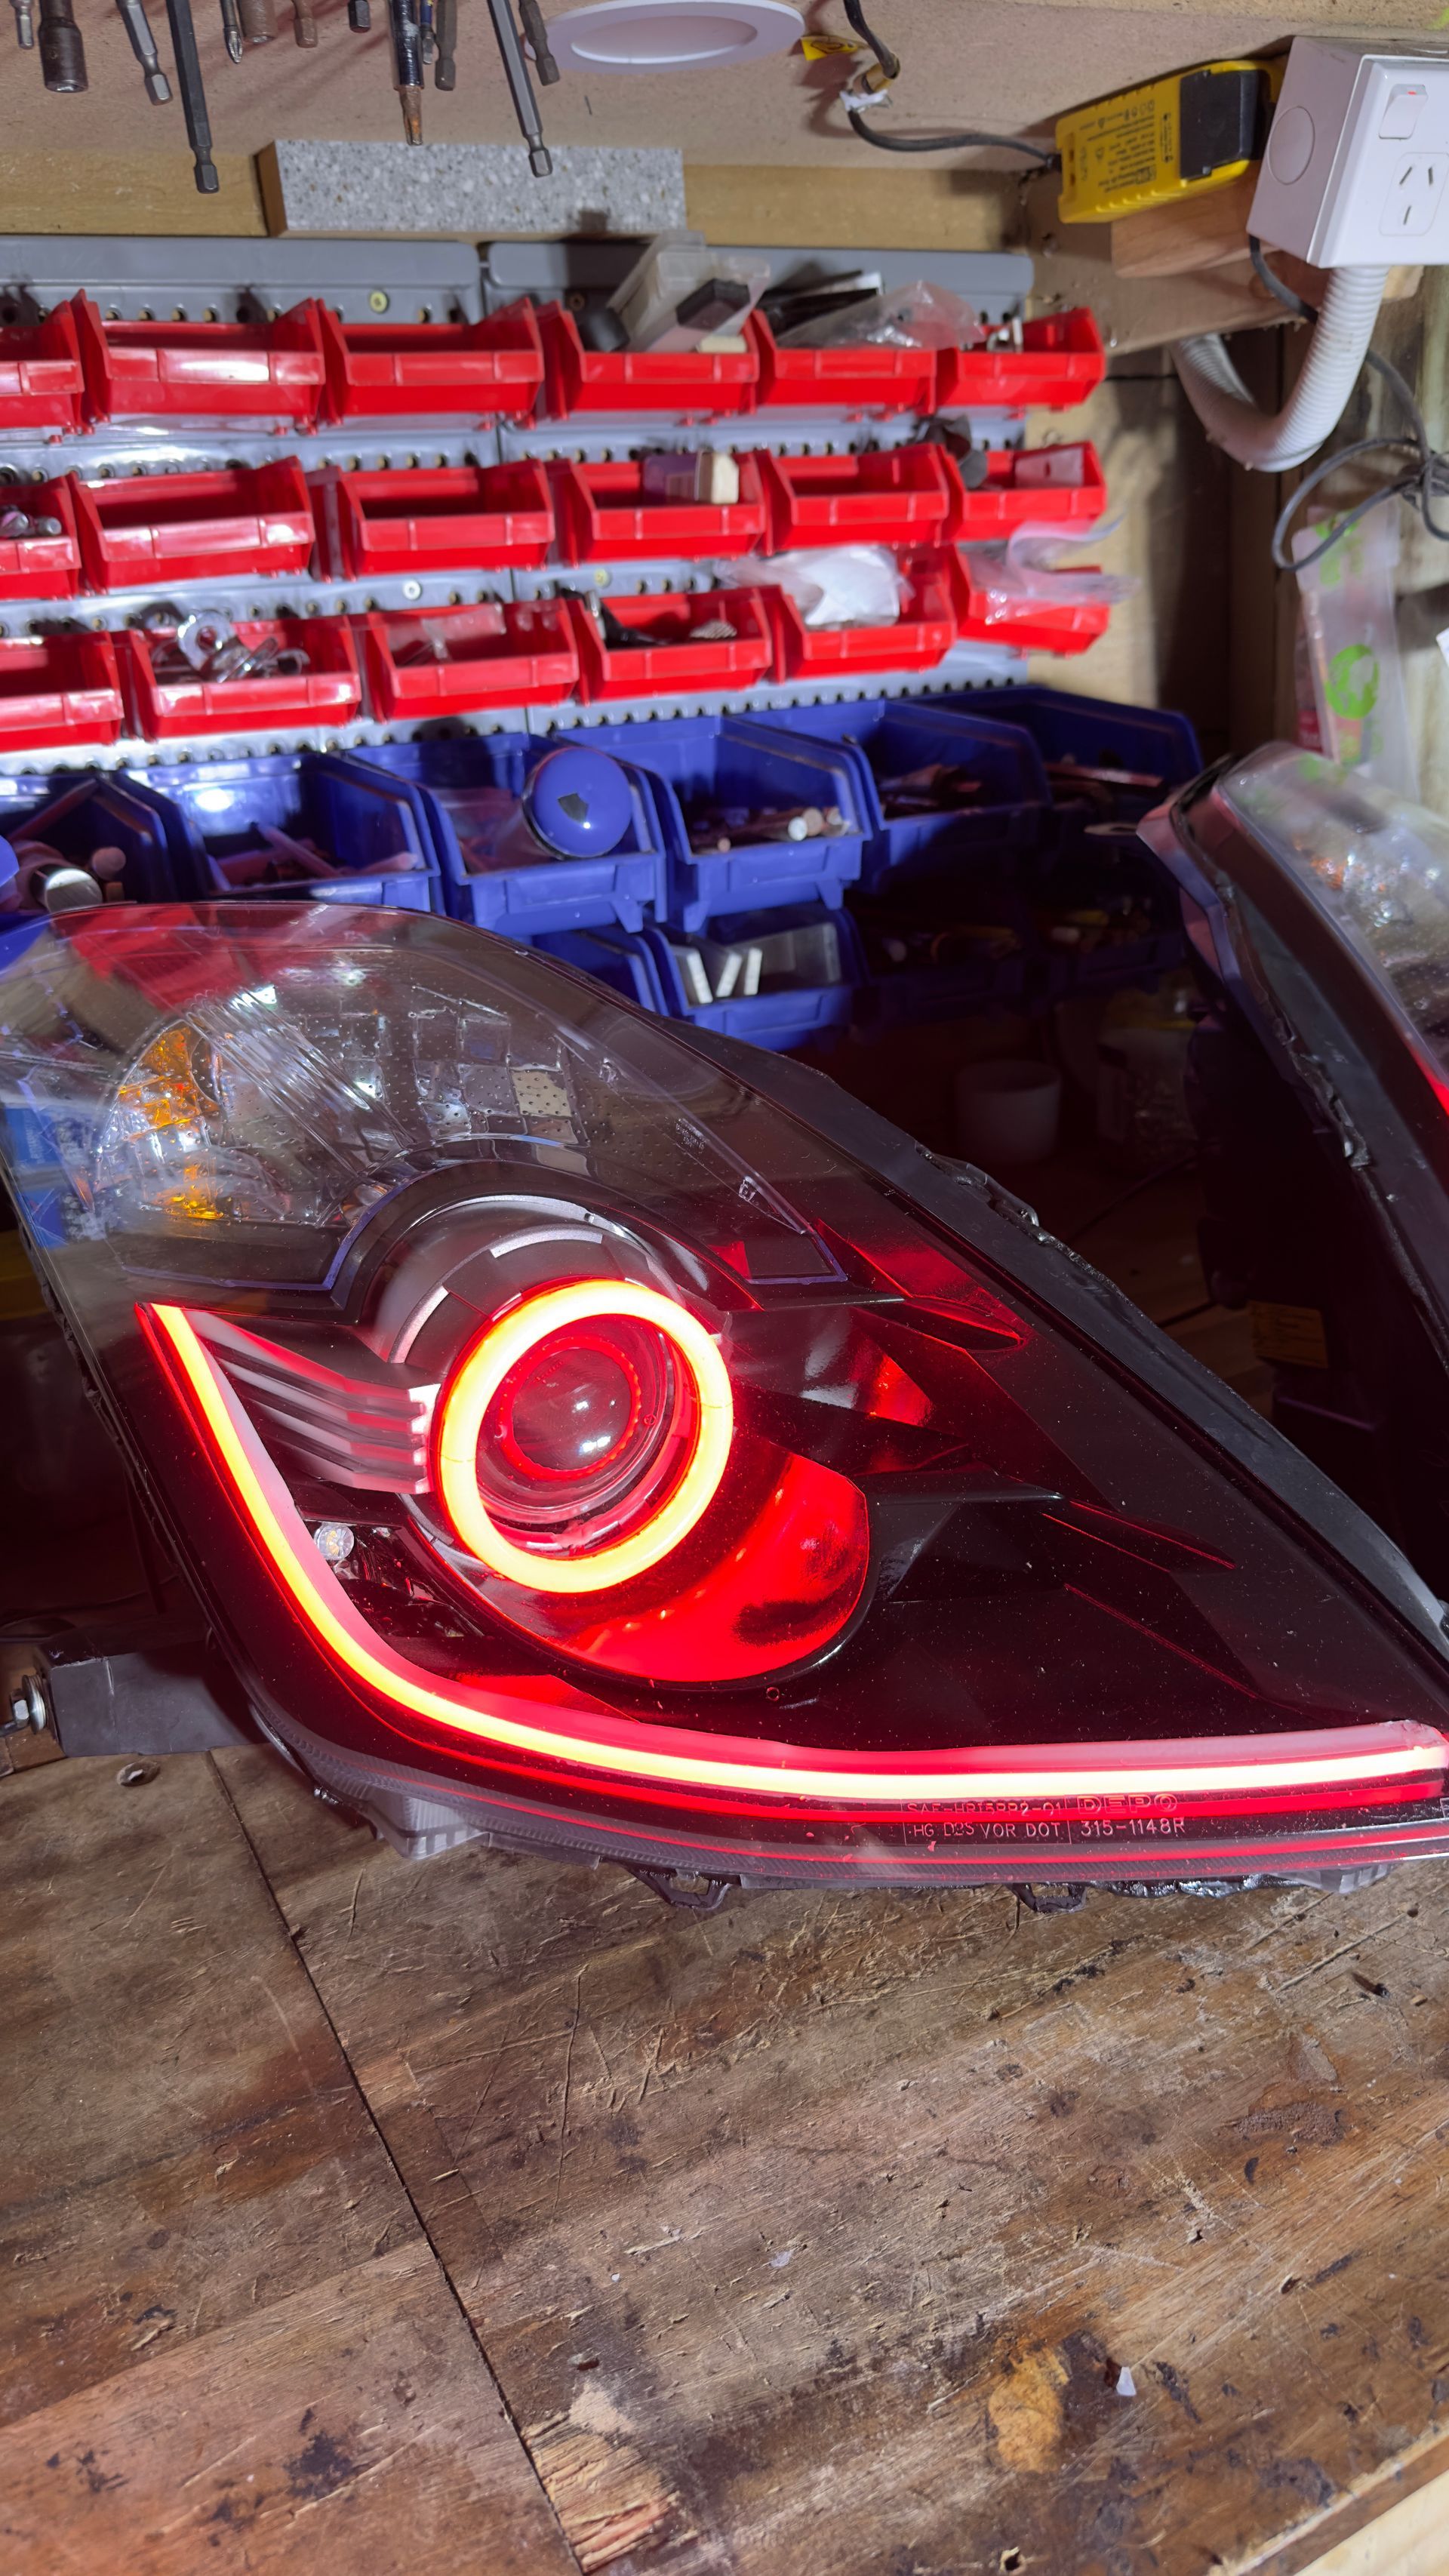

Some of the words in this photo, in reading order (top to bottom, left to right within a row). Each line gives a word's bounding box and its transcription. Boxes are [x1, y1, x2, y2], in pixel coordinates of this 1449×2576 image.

[1077, 1793, 1177, 1814] DEPO
[980, 1823, 1016, 1839] VOR
[1026, 1822, 1061, 1837] DOT
[1081, 1817, 1186, 1836] 315-1148R
